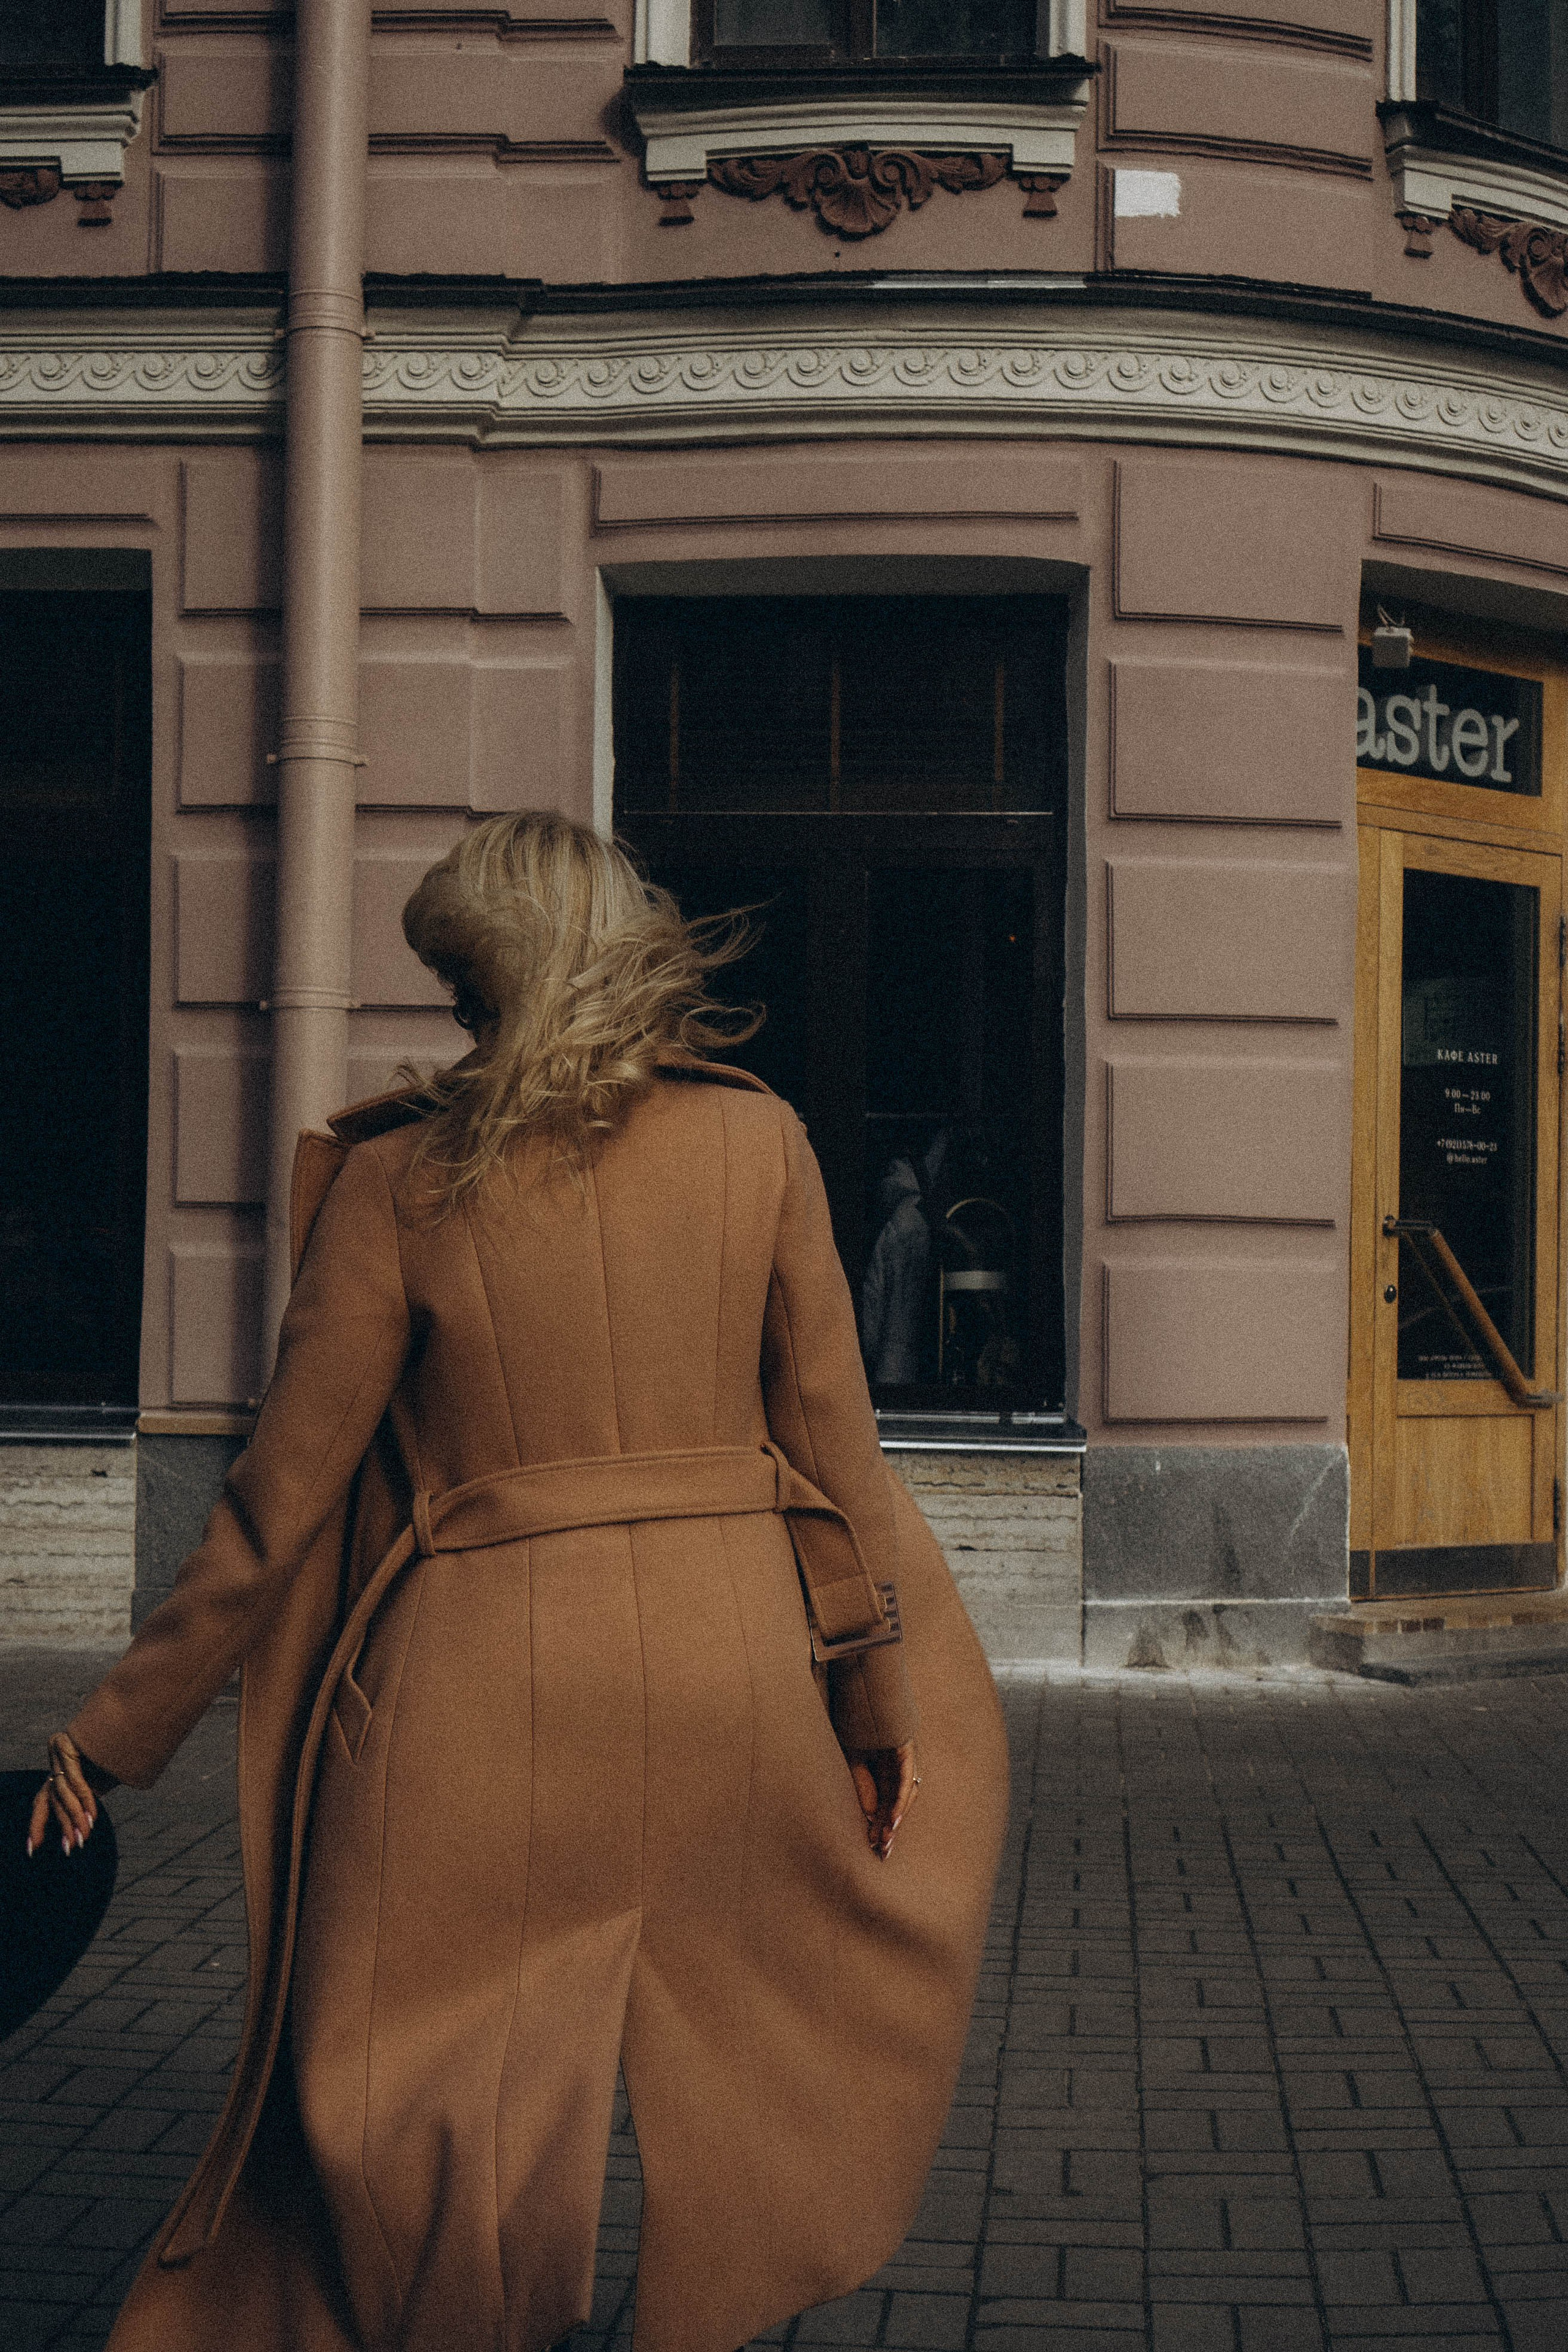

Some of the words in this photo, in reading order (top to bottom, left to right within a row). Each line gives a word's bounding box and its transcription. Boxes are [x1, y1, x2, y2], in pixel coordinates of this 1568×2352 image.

[1357, 684, 1520, 783] aster
[1437, 1048, 1463, 1063] КАФЕ
[1468, 1051, 1498, 1065] ASTER
